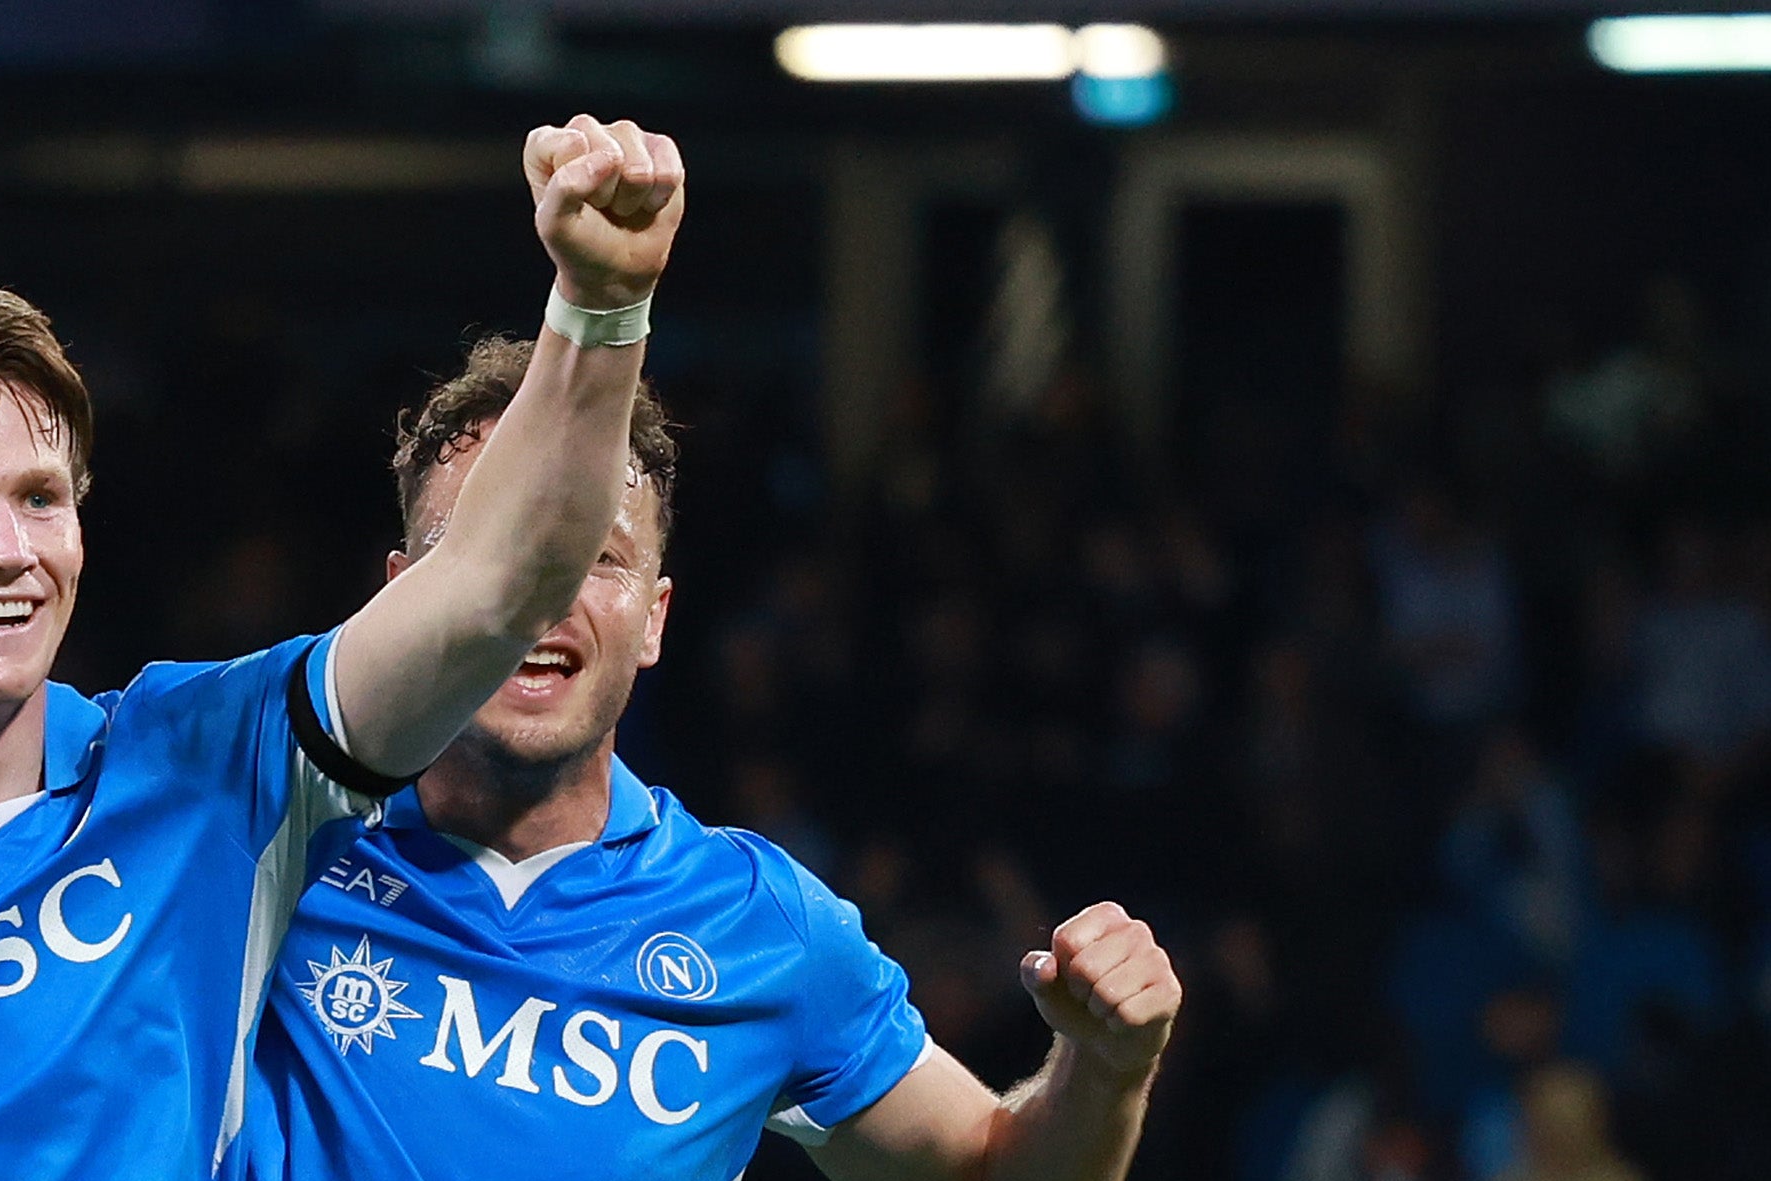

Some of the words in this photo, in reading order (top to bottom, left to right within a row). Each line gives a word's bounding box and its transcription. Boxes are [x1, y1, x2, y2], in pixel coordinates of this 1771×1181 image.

[320, 857, 408, 907] EA7
[657, 954, 693, 990] N
[419, 974, 708, 1125] MSC
